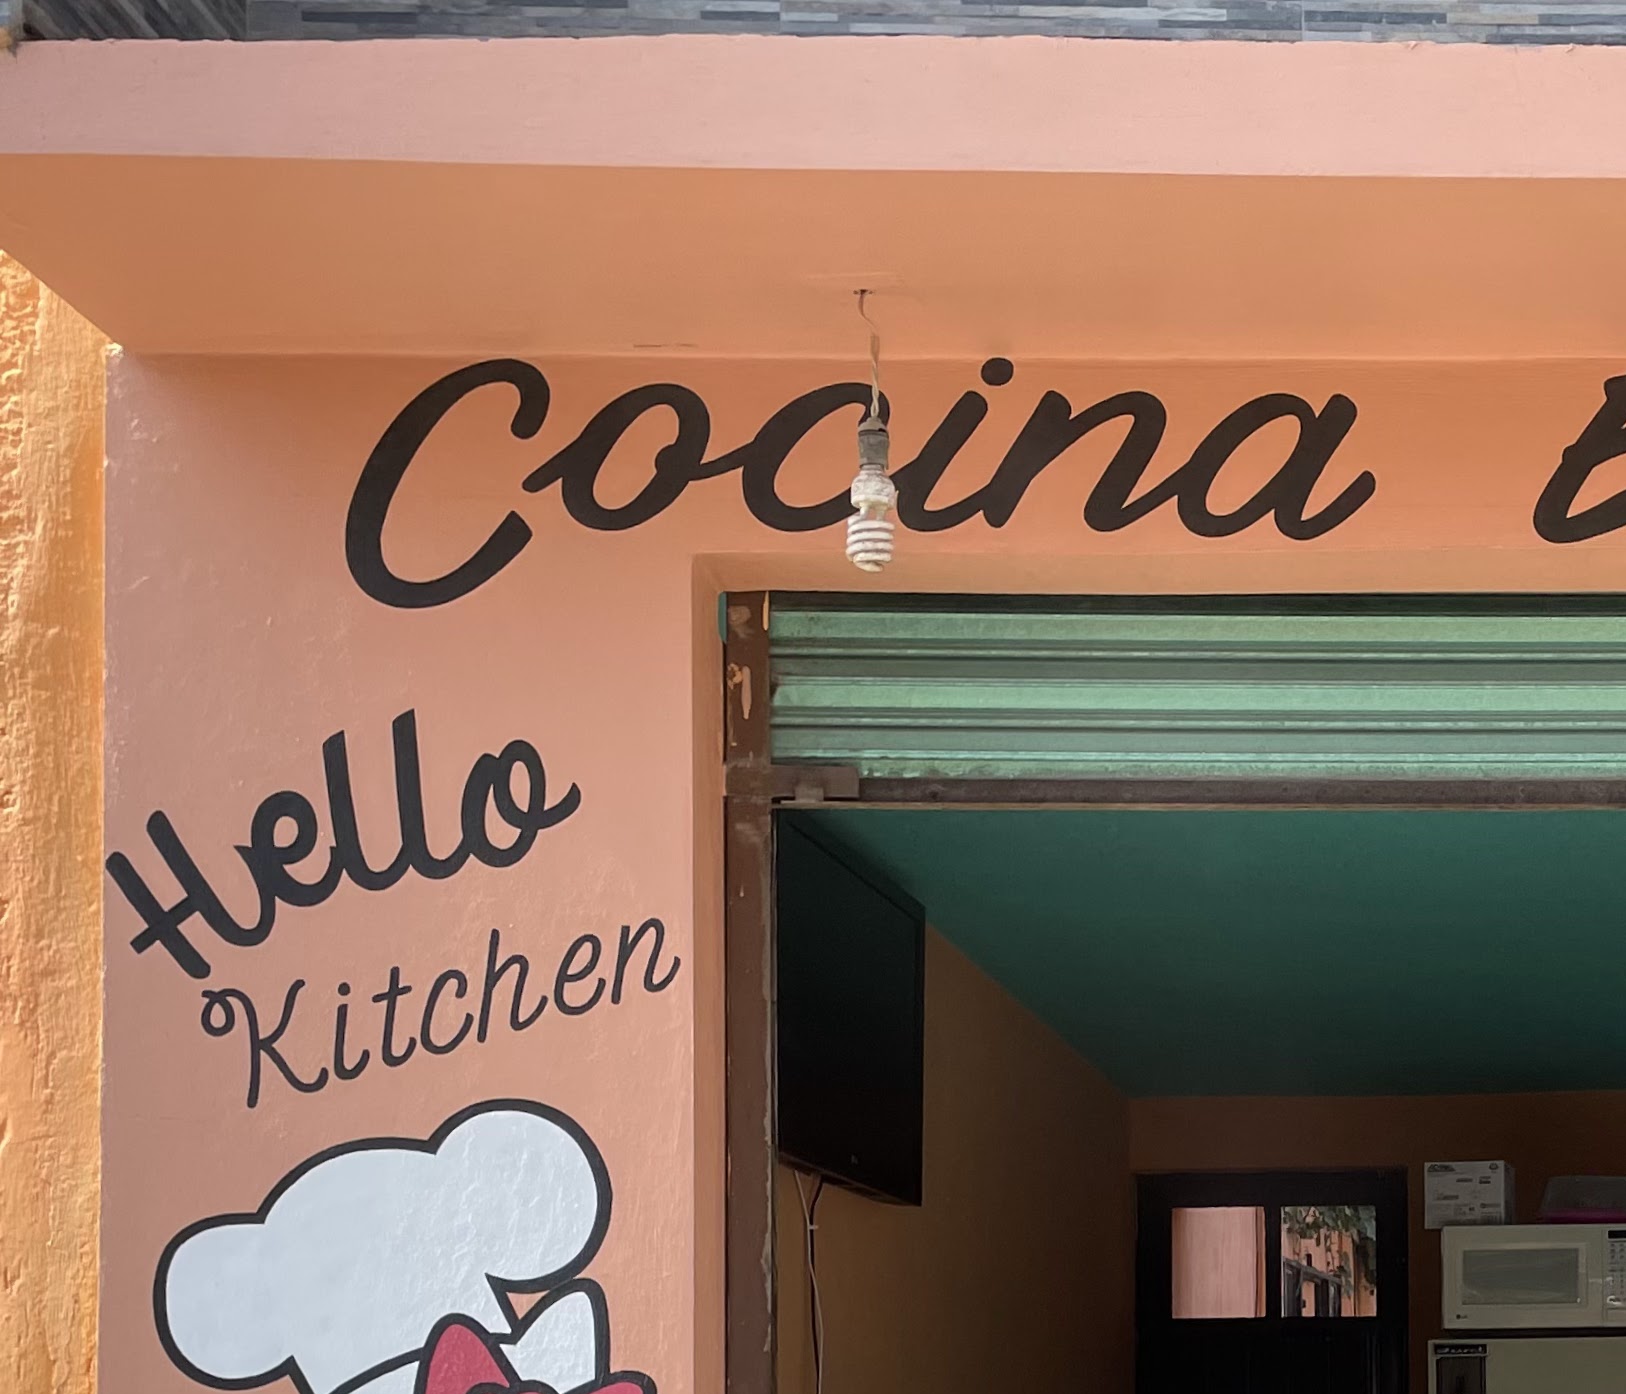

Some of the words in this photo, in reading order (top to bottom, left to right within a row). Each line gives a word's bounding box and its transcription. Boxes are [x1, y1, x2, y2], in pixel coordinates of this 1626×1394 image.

[345, 358, 1376, 608] Cocina
[106, 709, 581, 979] Hello
[201, 917, 681, 1109] Kitchen
